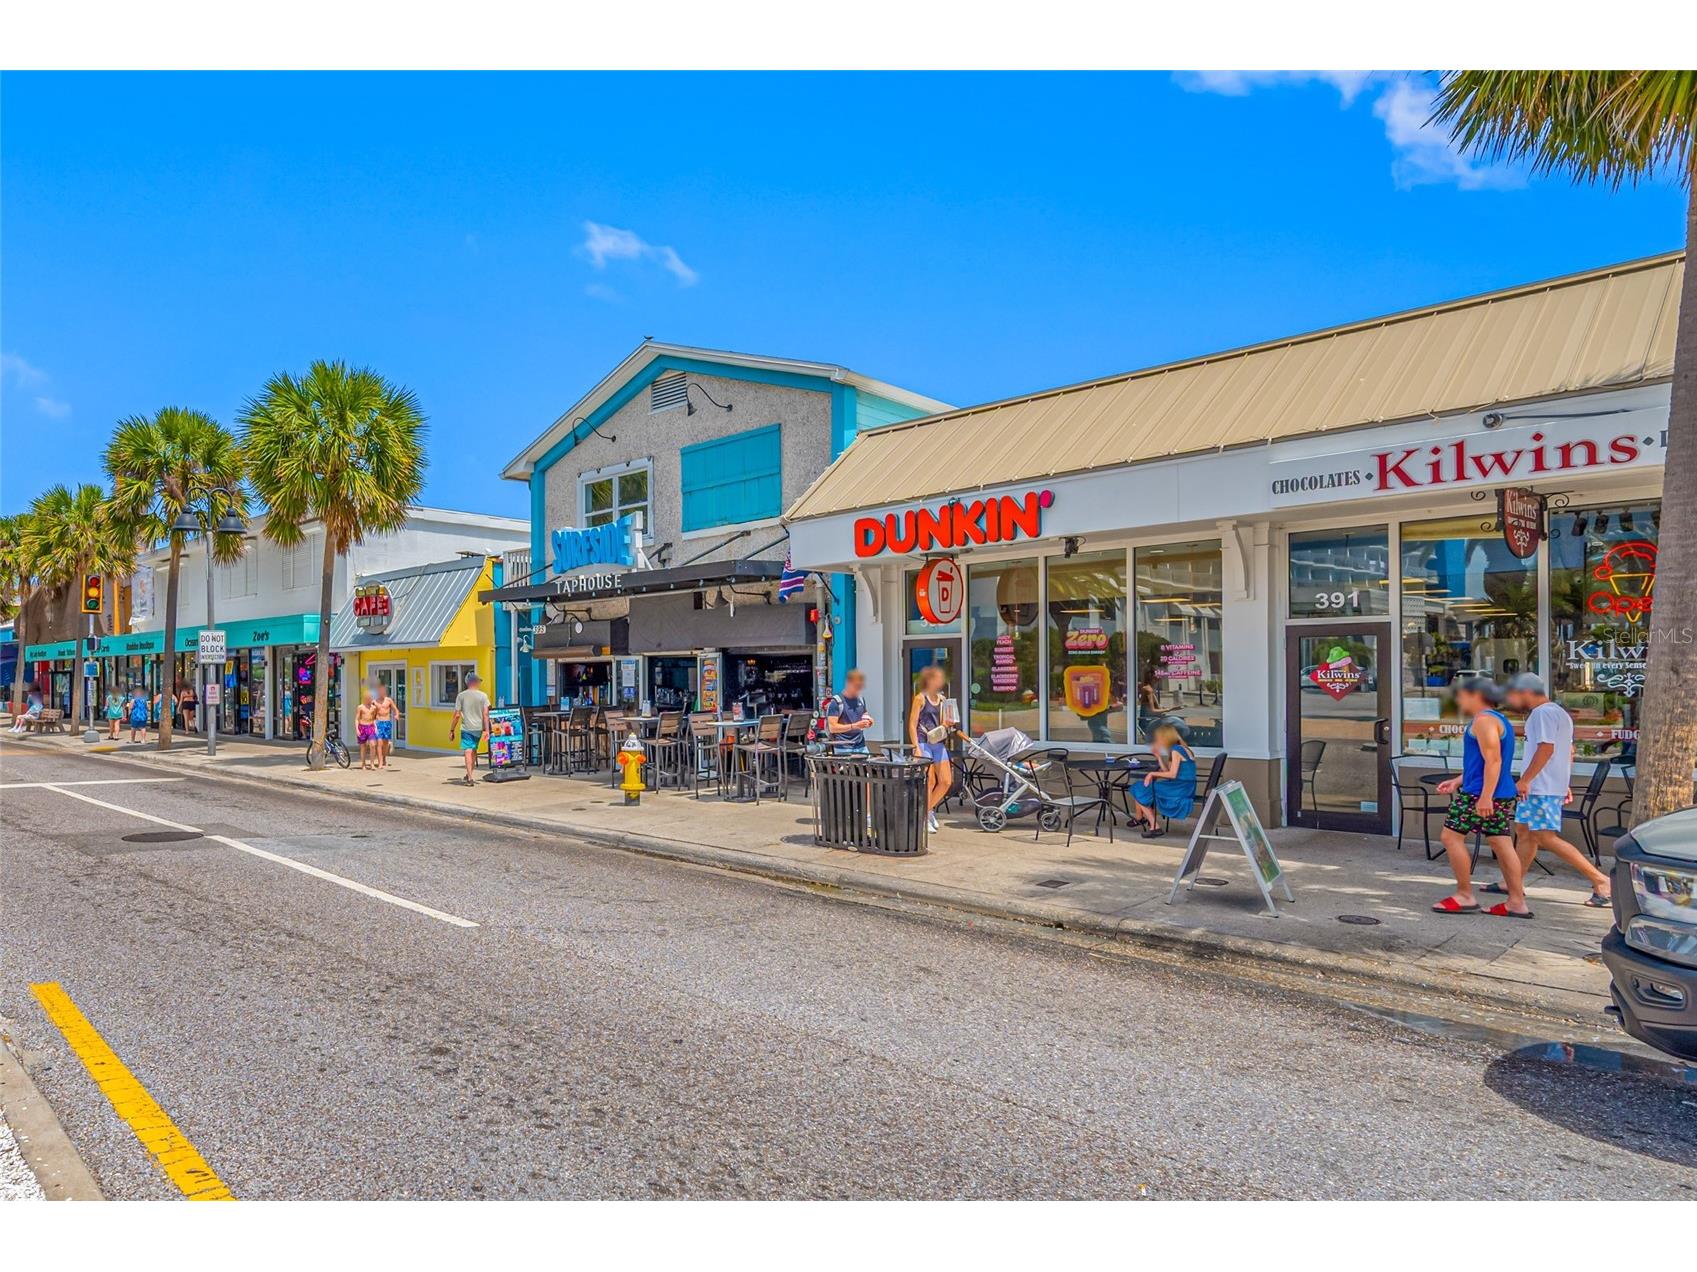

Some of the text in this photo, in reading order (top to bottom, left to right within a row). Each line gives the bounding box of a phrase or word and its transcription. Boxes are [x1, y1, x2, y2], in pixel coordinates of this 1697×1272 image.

[1272, 470, 1361, 495] CHOCOLATES
[1371, 432, 1640, 491] Kilwins
[1506, 489, 1537, 520] Kilwins
[854, 490, 1054, 558] DUNKIN'
[552, 517, 634, 574] SURFSIDE
[555, 574, 623, 594] TAPHOUSE
[1315, 591, 1360, 609] 391
[1587, 591, 1654, 617] Ope
[201, 634, 224, 643] DO NOT
[252, 631, 270, 642] Zoe's
[1066, 631, 1107, 649] Zero
[201, 645, 225, 653] BLOCK
[1567, 639, 1648, 660] Kilw
[1317, 670, 1360, 679] Kilwins
[1439, 724, 1467, 734] CHOC
[1611, 729, 1640, 740] FUDG
